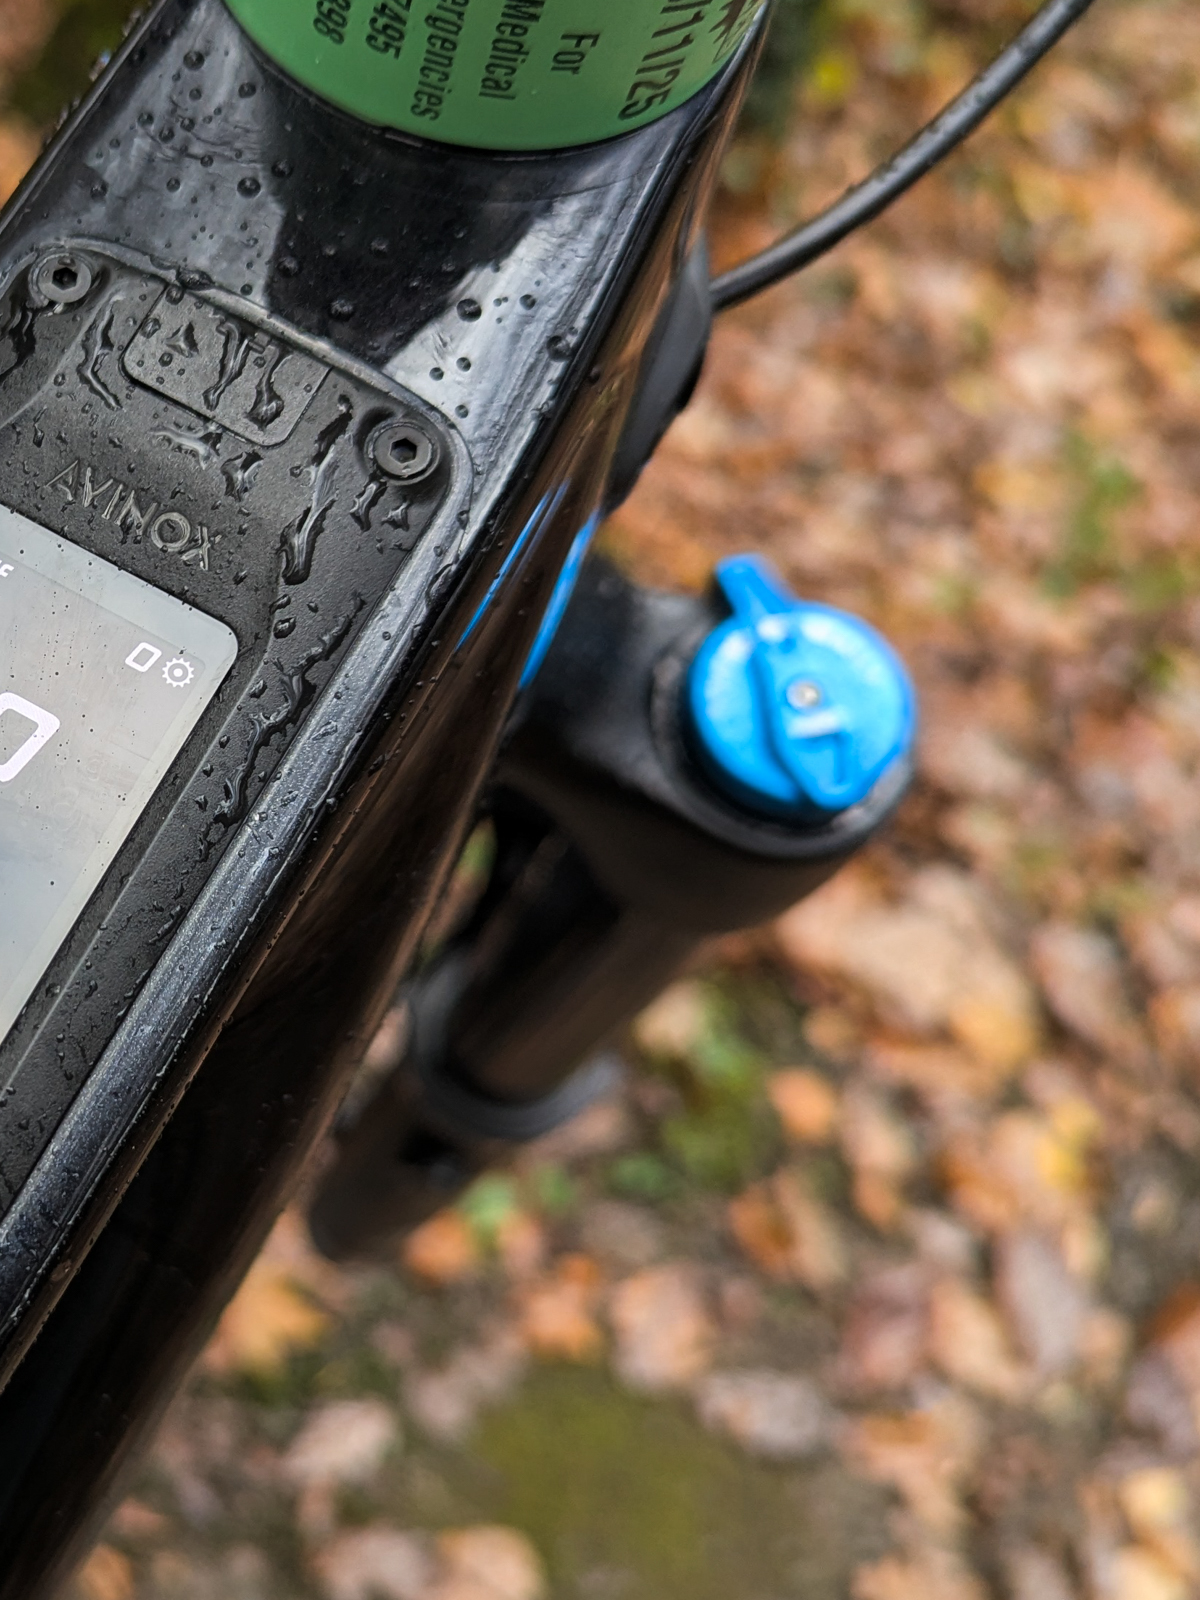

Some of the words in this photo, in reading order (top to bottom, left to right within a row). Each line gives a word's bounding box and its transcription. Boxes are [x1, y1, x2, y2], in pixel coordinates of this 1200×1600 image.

[479, 0, 545, 100] Medical
[551, 33, 600, 75] For
[618, 0, 712, 120] /11/25
[44, 459, 223, 571] AVINOX
[125, 641, 162, 673] 0
